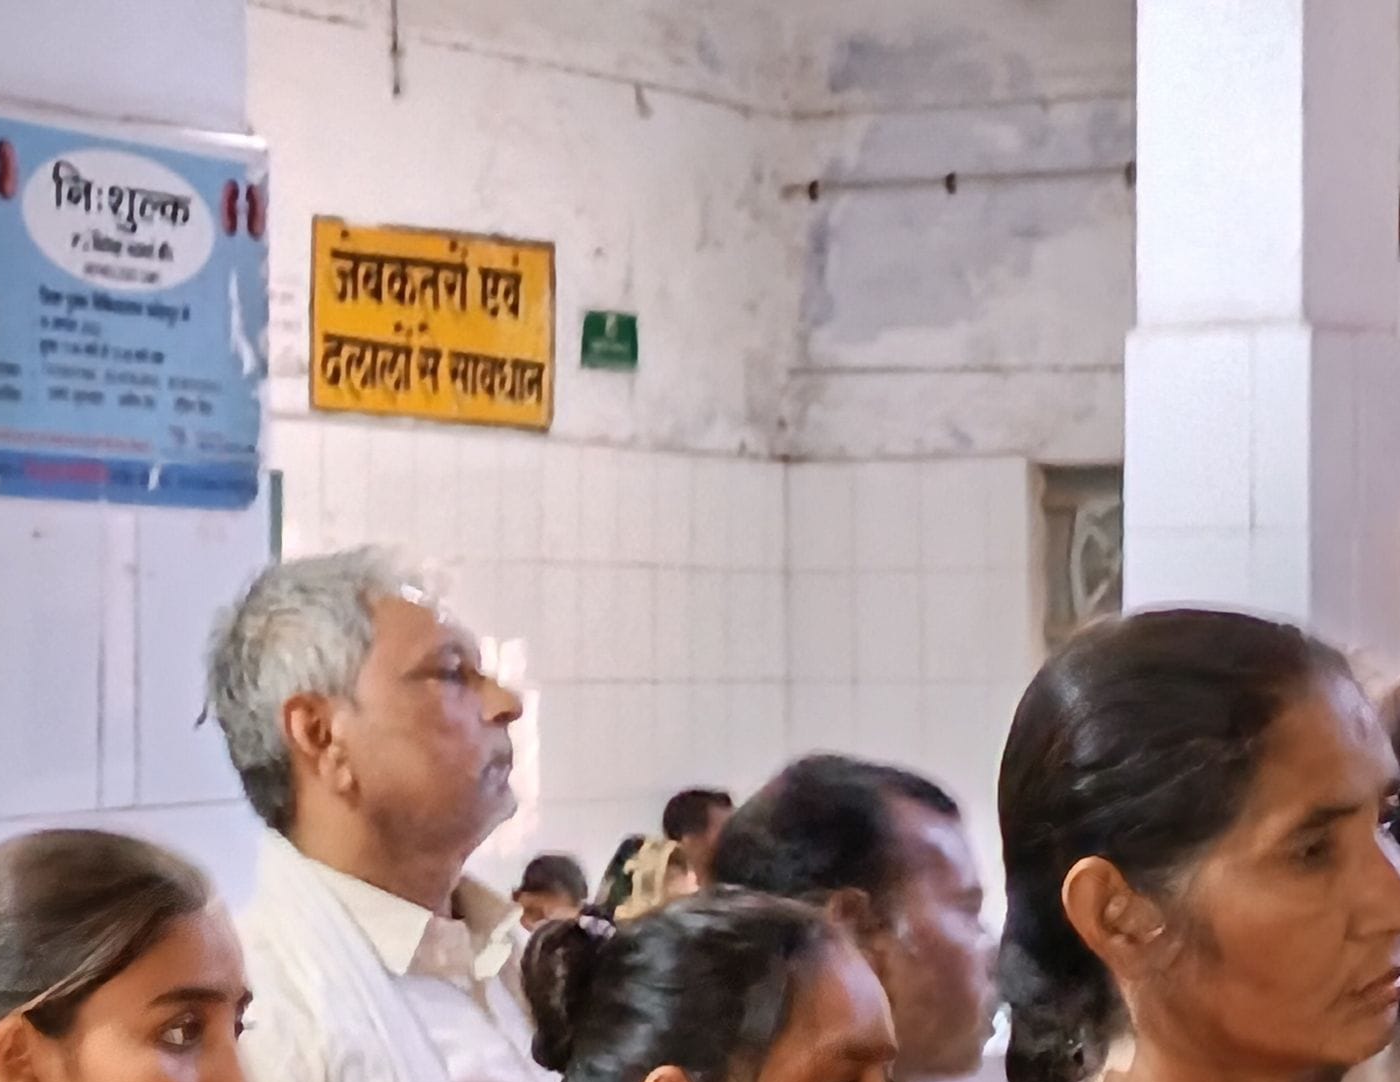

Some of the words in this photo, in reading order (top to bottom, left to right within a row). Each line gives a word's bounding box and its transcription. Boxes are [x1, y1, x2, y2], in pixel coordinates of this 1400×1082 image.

[478, 252, 522, 319] एवं
[320, 321, 414, 393] दलालों
[417, 321, 443, 395] से
[447, 349, 545, 404] सावधान
